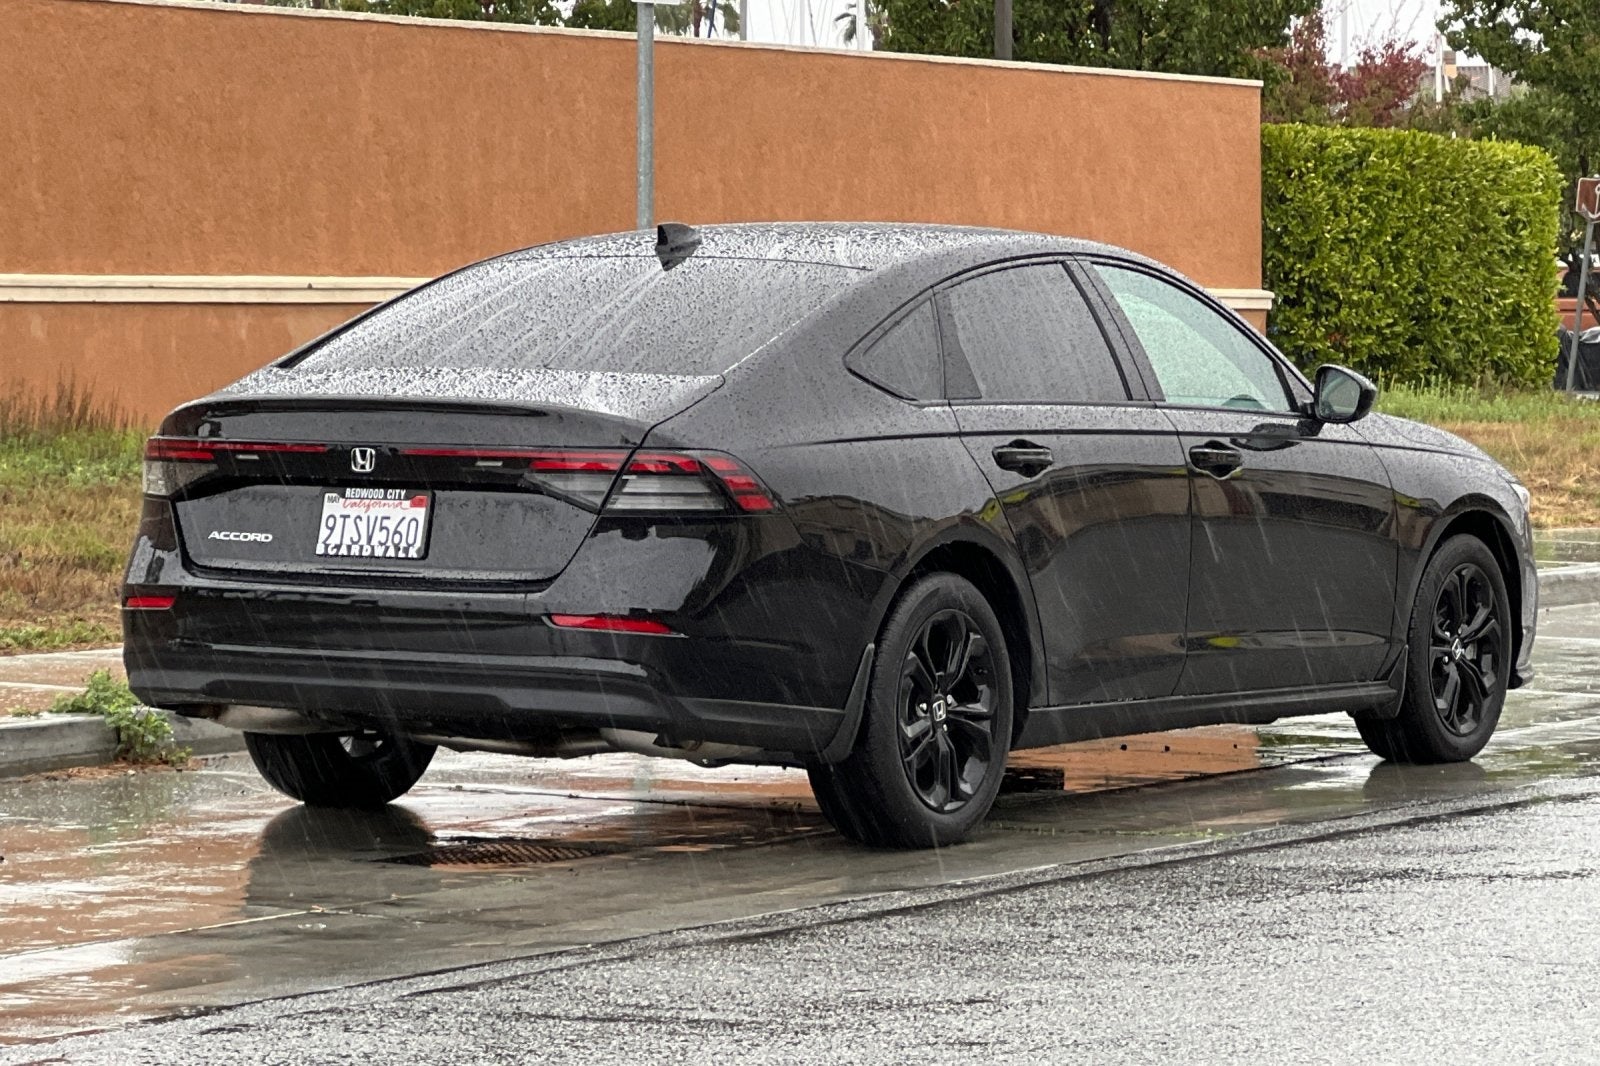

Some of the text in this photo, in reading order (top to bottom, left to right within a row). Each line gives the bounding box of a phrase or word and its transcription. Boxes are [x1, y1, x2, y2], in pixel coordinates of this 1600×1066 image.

[326, 495, 340, 504] MAY
[345, 488, 407, 500] REDWOOD CITY
[342, 498, 410, 513] California
[322, 514, 419, 547] 9TSV560
[208, 531, 273, 543] ACCORD
